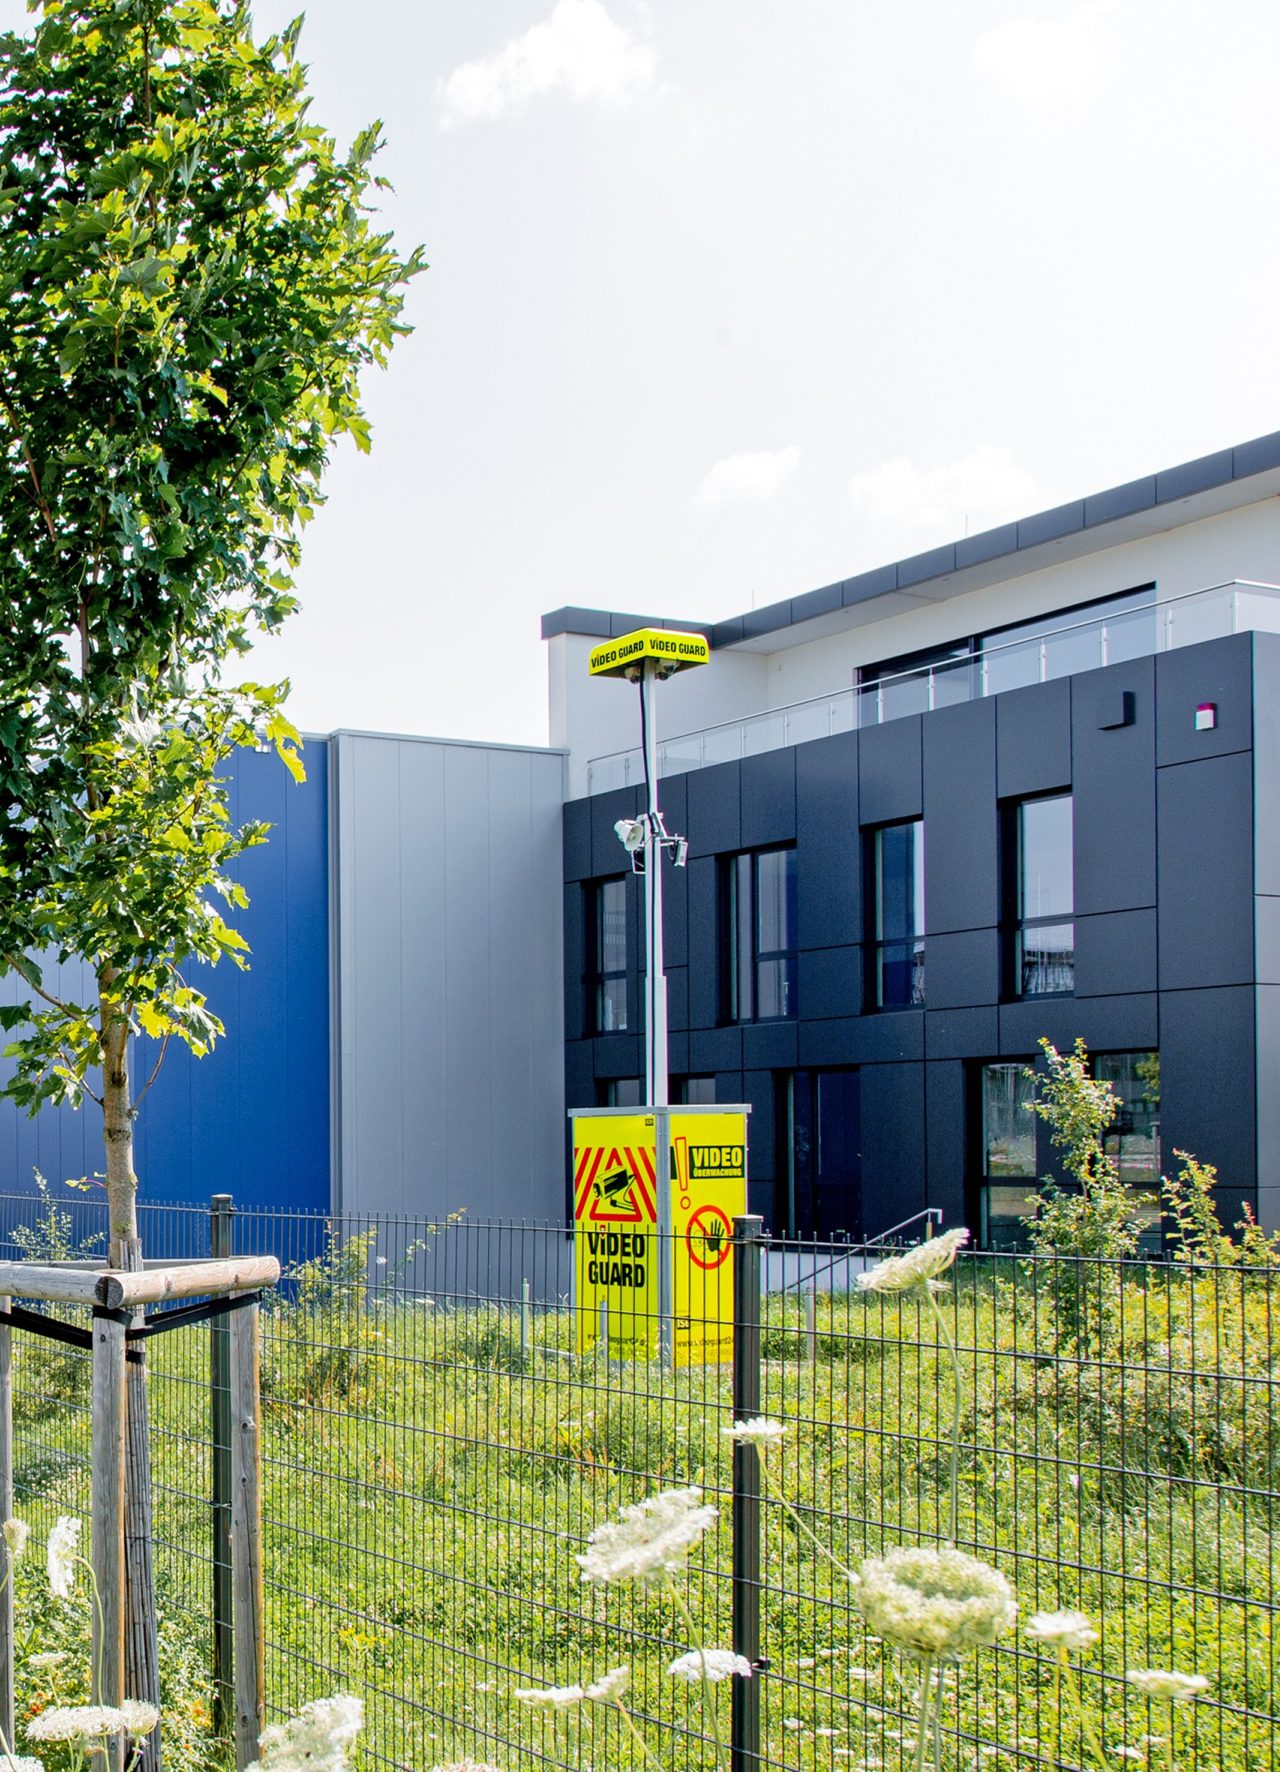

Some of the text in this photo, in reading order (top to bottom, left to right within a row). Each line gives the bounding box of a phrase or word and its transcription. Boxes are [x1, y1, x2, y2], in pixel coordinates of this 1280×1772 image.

[618, 640, 644, 658] GUARD
[678, 643, 706, 656] GUARD
[691, 1147, 742, 1167] VIDEO
[693, 1167, 742, 1178] ÜBERWACHUNG
[588, 1260, 646, 1288] GUARD
